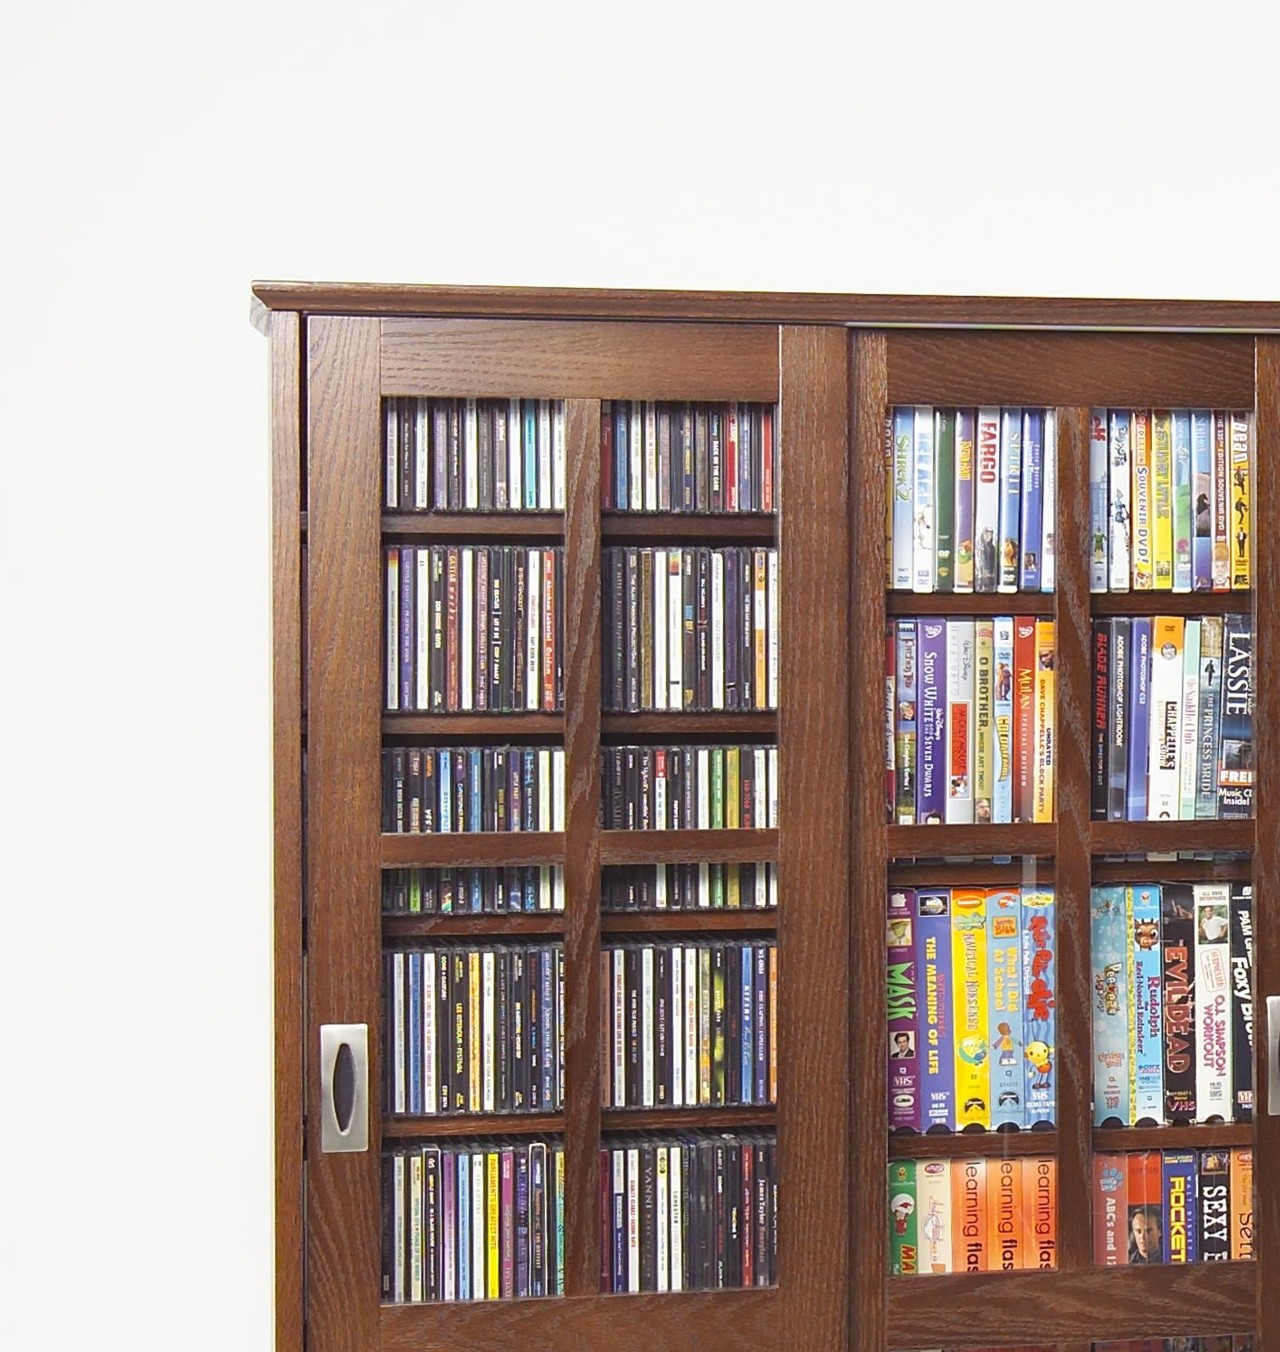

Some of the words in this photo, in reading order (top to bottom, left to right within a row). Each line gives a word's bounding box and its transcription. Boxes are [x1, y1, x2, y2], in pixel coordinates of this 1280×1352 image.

[980, 422, 997, 483] FARGO
[1008, 432, 1020, 495] SPIRIT
[1218, 449, 1226, 477] EDITION
[1137, 467, 1149, 525] SOUVENIR
[1138, 529, 1149, 563] DVD!
[1097, 633, 1107, 672] BLADE
[1227, 632, 1250, 715] LASSIE
[1096, 675, 1107, 729] RUNNER
[1116, 661, 1124, 702] PHOTOSHOP
[1167, 703, 1177, 768] CHAPPELLE'S
[1202, 709, 1213, 760] PRINCESS
[1201, 763, 1212, 798] BRIDE
[926, 937, 937, 960] THE
[963, 933, 979, 978] NAUTICAL
[1007, 947, 1018, 977] What
[886, 962, 916, 1020] MASK
[927, 964, 938, 1025] MEANING
[994, 968, 1005, 1010] School
[1007, 992, 1018, 1012] Did
[1232, 957, 1253, 1000] Foxy
[966, 981, 979, 1031] NONSENSE
[1147, 976, 1160, 1039] Rudolph
[928, 1029, 938, 1046] OF
[1203, 1004, 1215, 1068] WORKOUT
[1215, 1020, 1226, 1077] SIMPSON
[928, 1050, 938, 1075] LIFE
[645, 1167, 653, 1208] YANNI
[963, 1162, 981, 1237] learning
[998, 1159, 1016, 1234] learning
[1035, 1160, 1053, 1235] learning
[1203, 1186, 1228, 1241] SEXY
[1106, 1230, 1116, 1251] and
